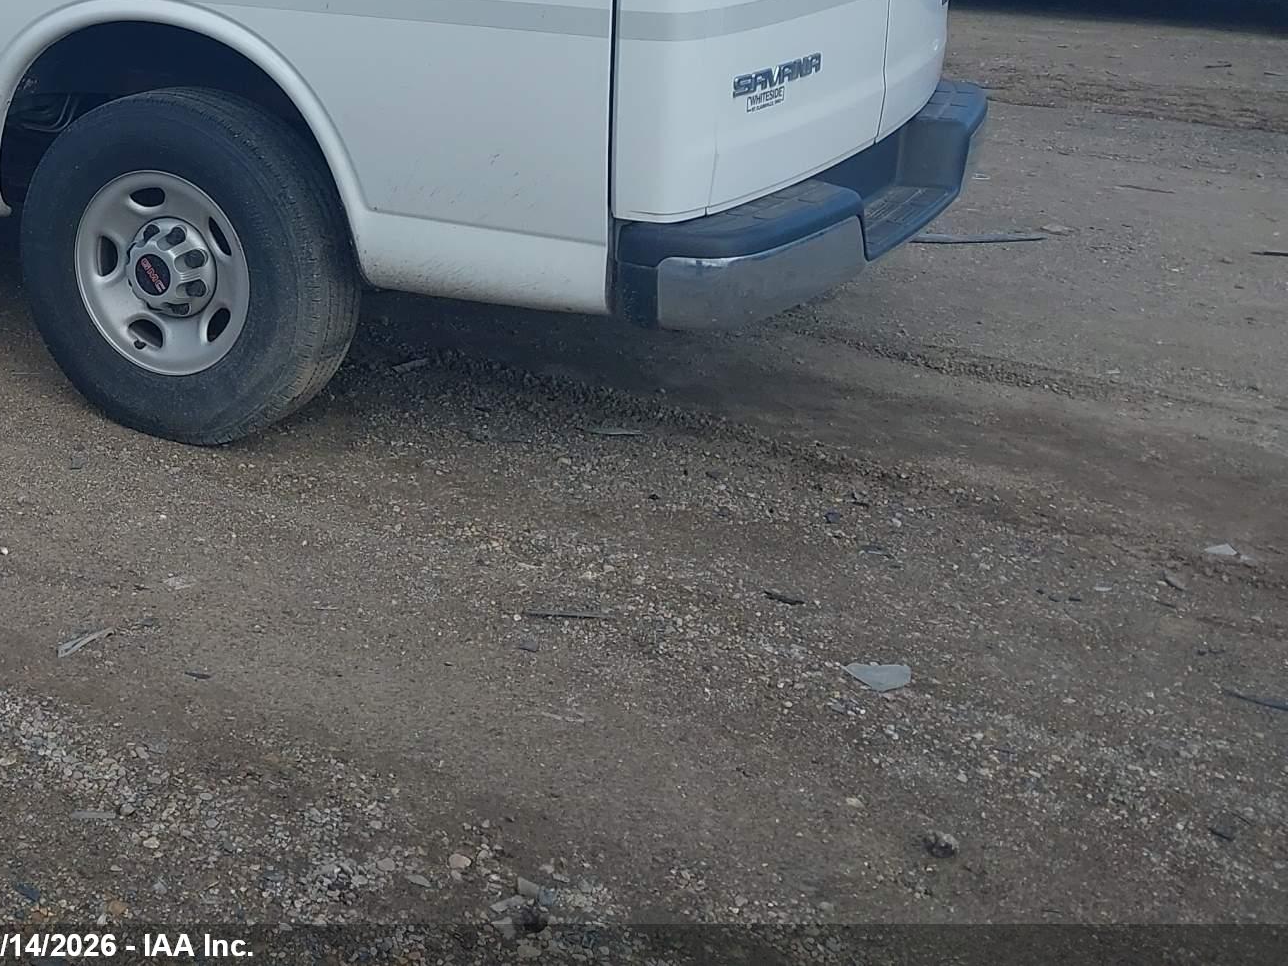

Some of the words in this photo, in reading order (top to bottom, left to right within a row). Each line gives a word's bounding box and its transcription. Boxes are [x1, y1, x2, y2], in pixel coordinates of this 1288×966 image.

[733, 52, 821, 98] SAVANA
[751, 87, 782, 106] WHITESIDE
[141, 257, 166, 293] GMC
